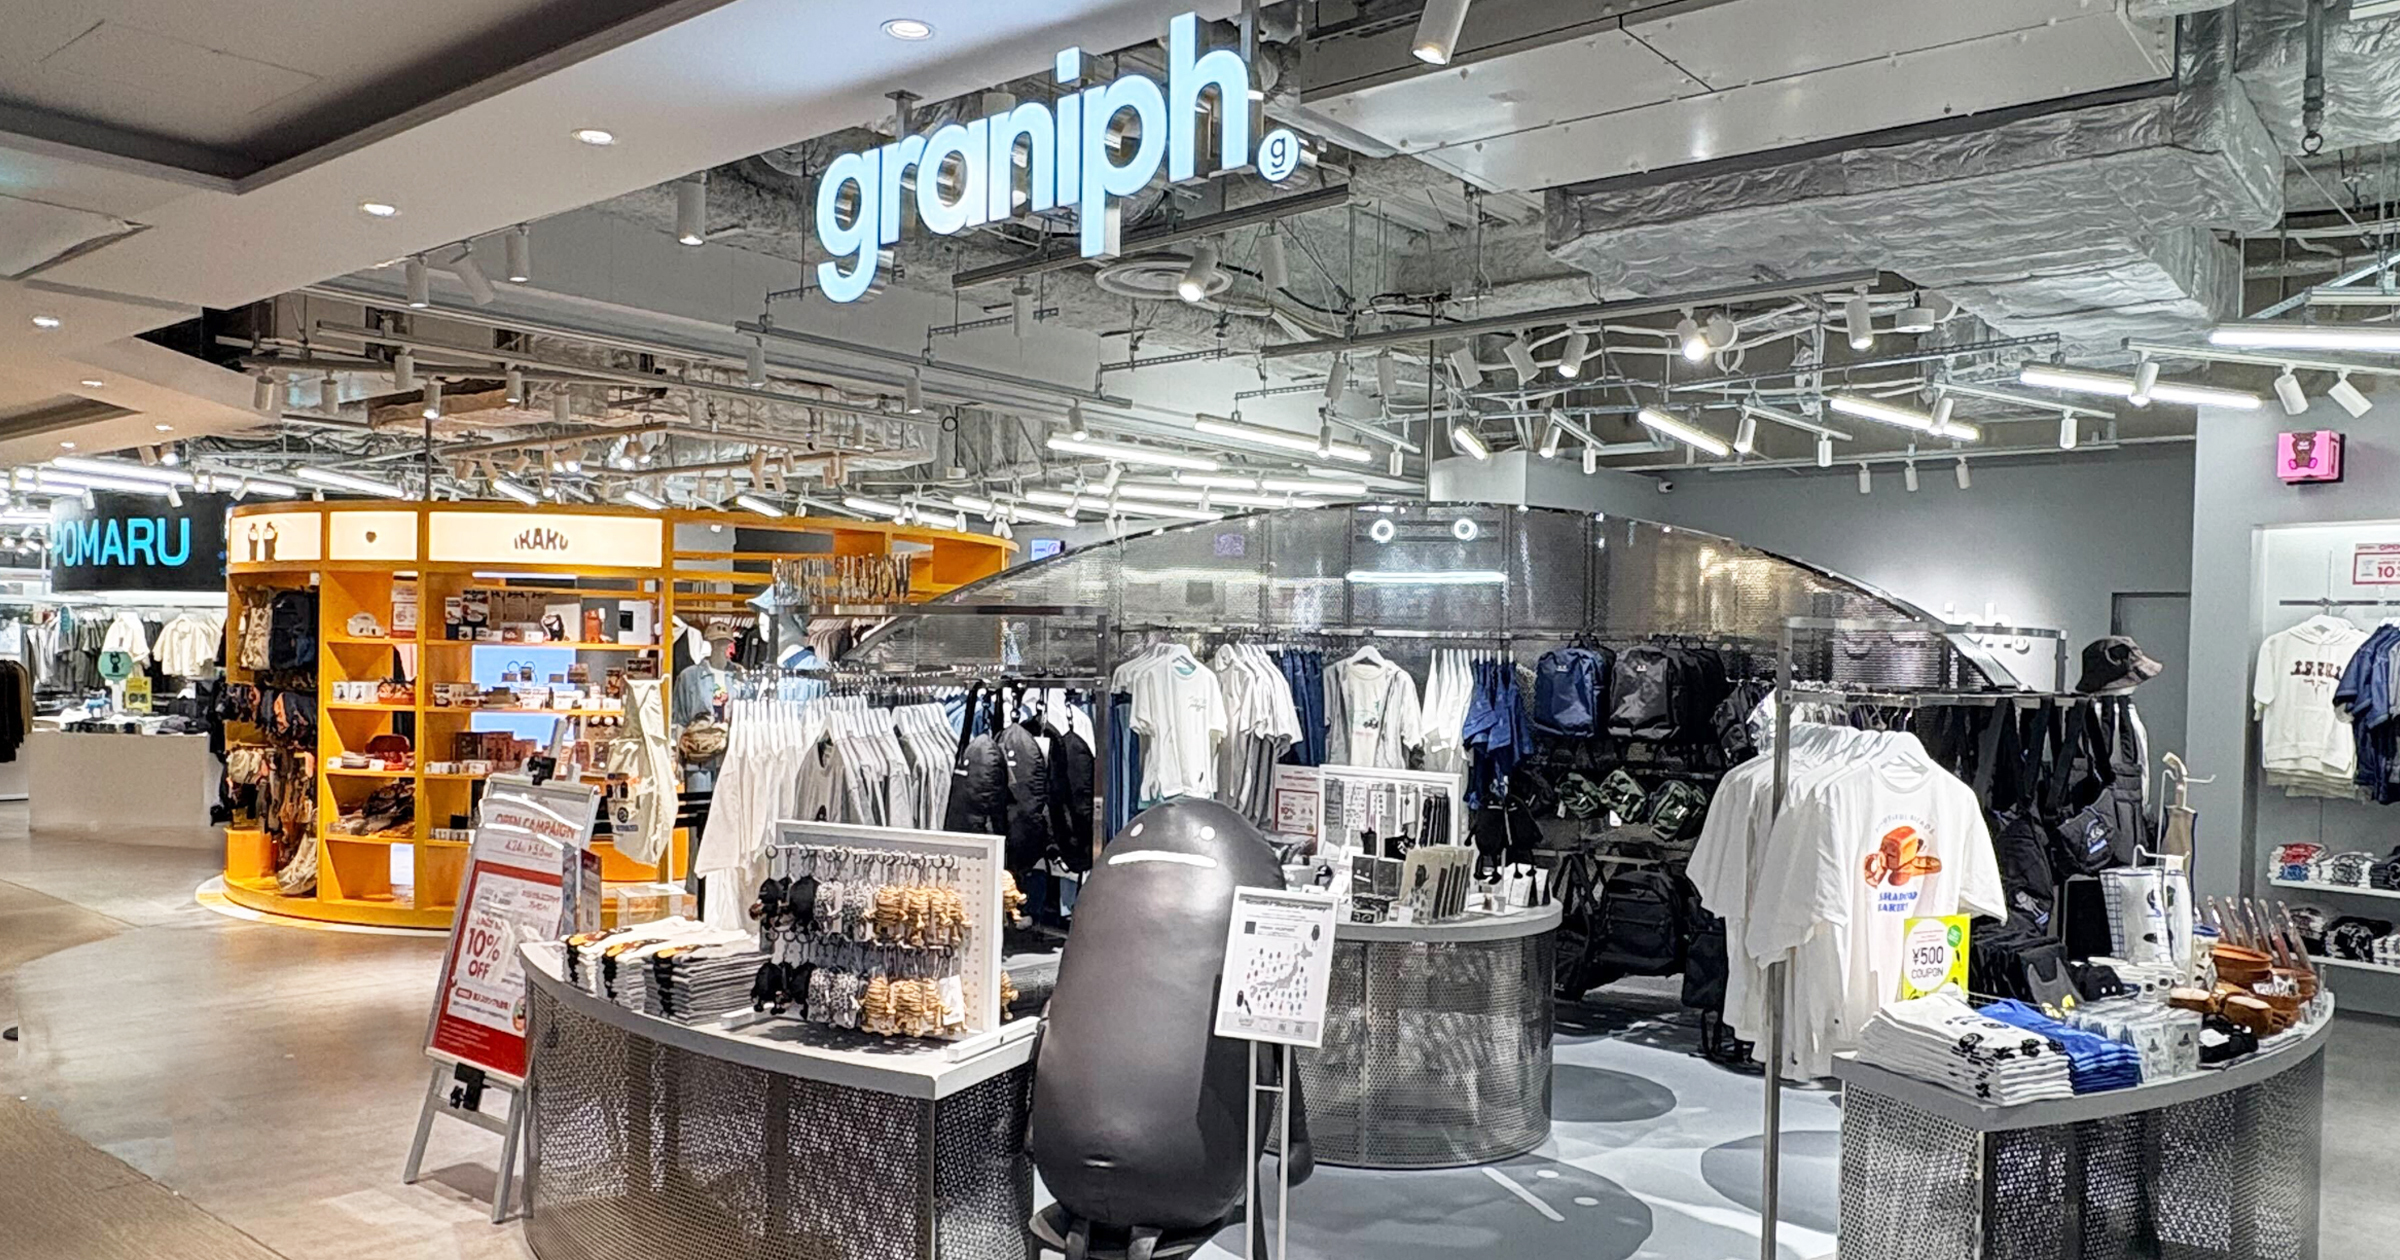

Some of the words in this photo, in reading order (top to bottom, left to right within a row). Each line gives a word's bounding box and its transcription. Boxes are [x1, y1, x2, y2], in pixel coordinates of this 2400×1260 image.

[816, 11, 1250, 303] graniph
[514, 527, 569, 551] IKAKU
[465, 927, 501, 962] 10%
[1912, 945, 1944, 966] ¥500
[467, 959, 491, 980] OFF
[1911, 967, 1944, 980] COUPON
